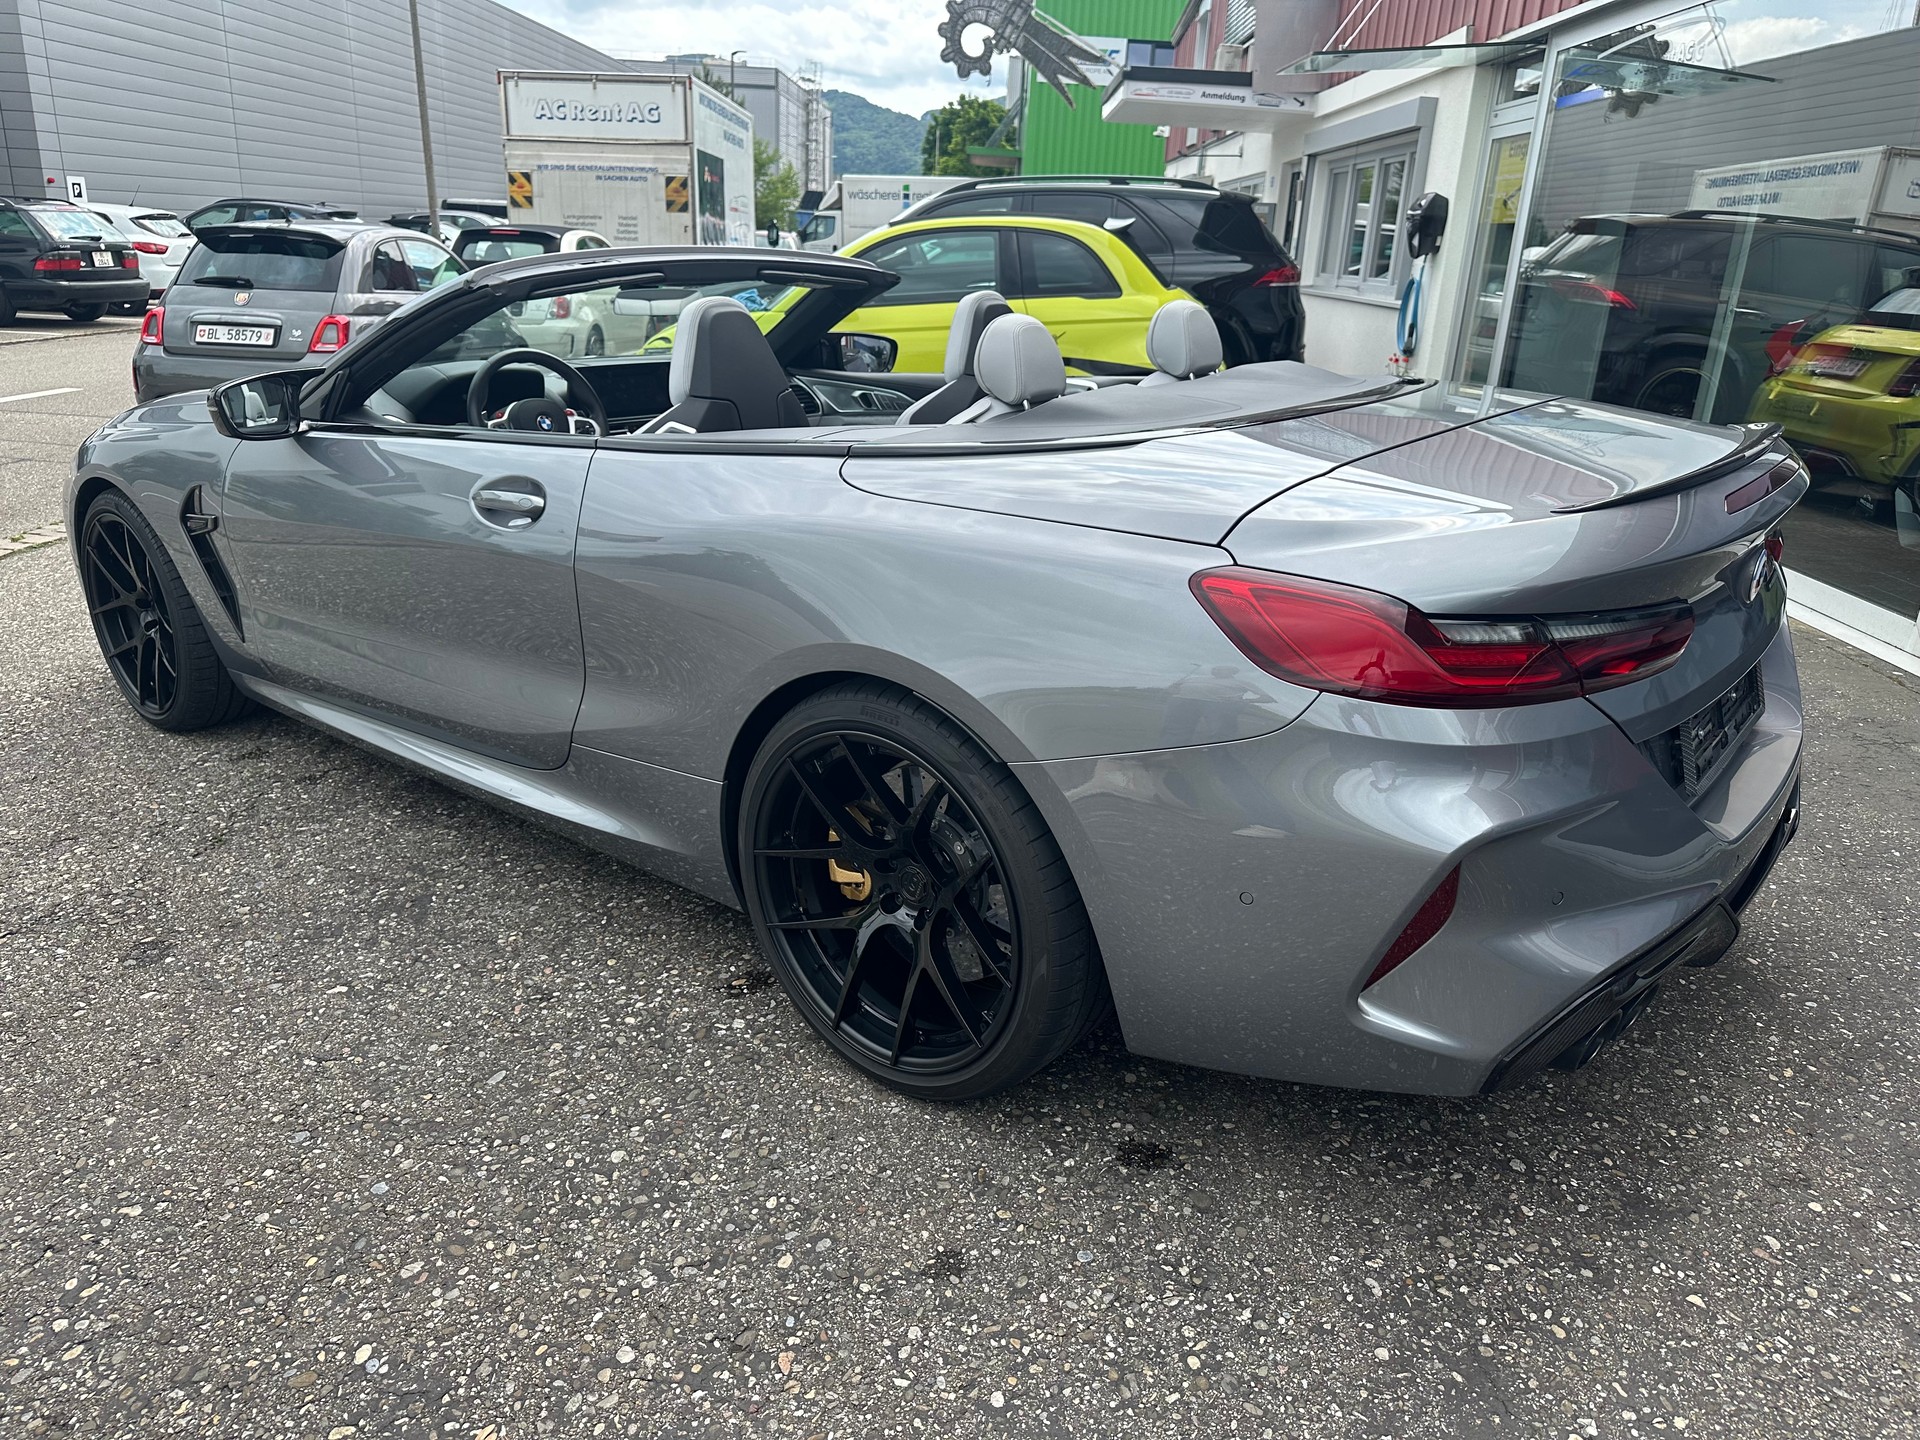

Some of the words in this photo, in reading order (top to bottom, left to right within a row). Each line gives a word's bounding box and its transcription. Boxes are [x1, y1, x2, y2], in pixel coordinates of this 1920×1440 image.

[1200, 91, 1247, 104] Anmeldung
[534, 98, 567, 121] AC
[569, 100, 622, 123] Rent
[624, 101, 662, 124] AG
[550, 164, 565, 172] SIND
[74, 184, 80, 196] P
[847, 189, 902, 201] wäscherei
[207, 328, 220, 340] BL
[226, 329, 263, 342] 58579
